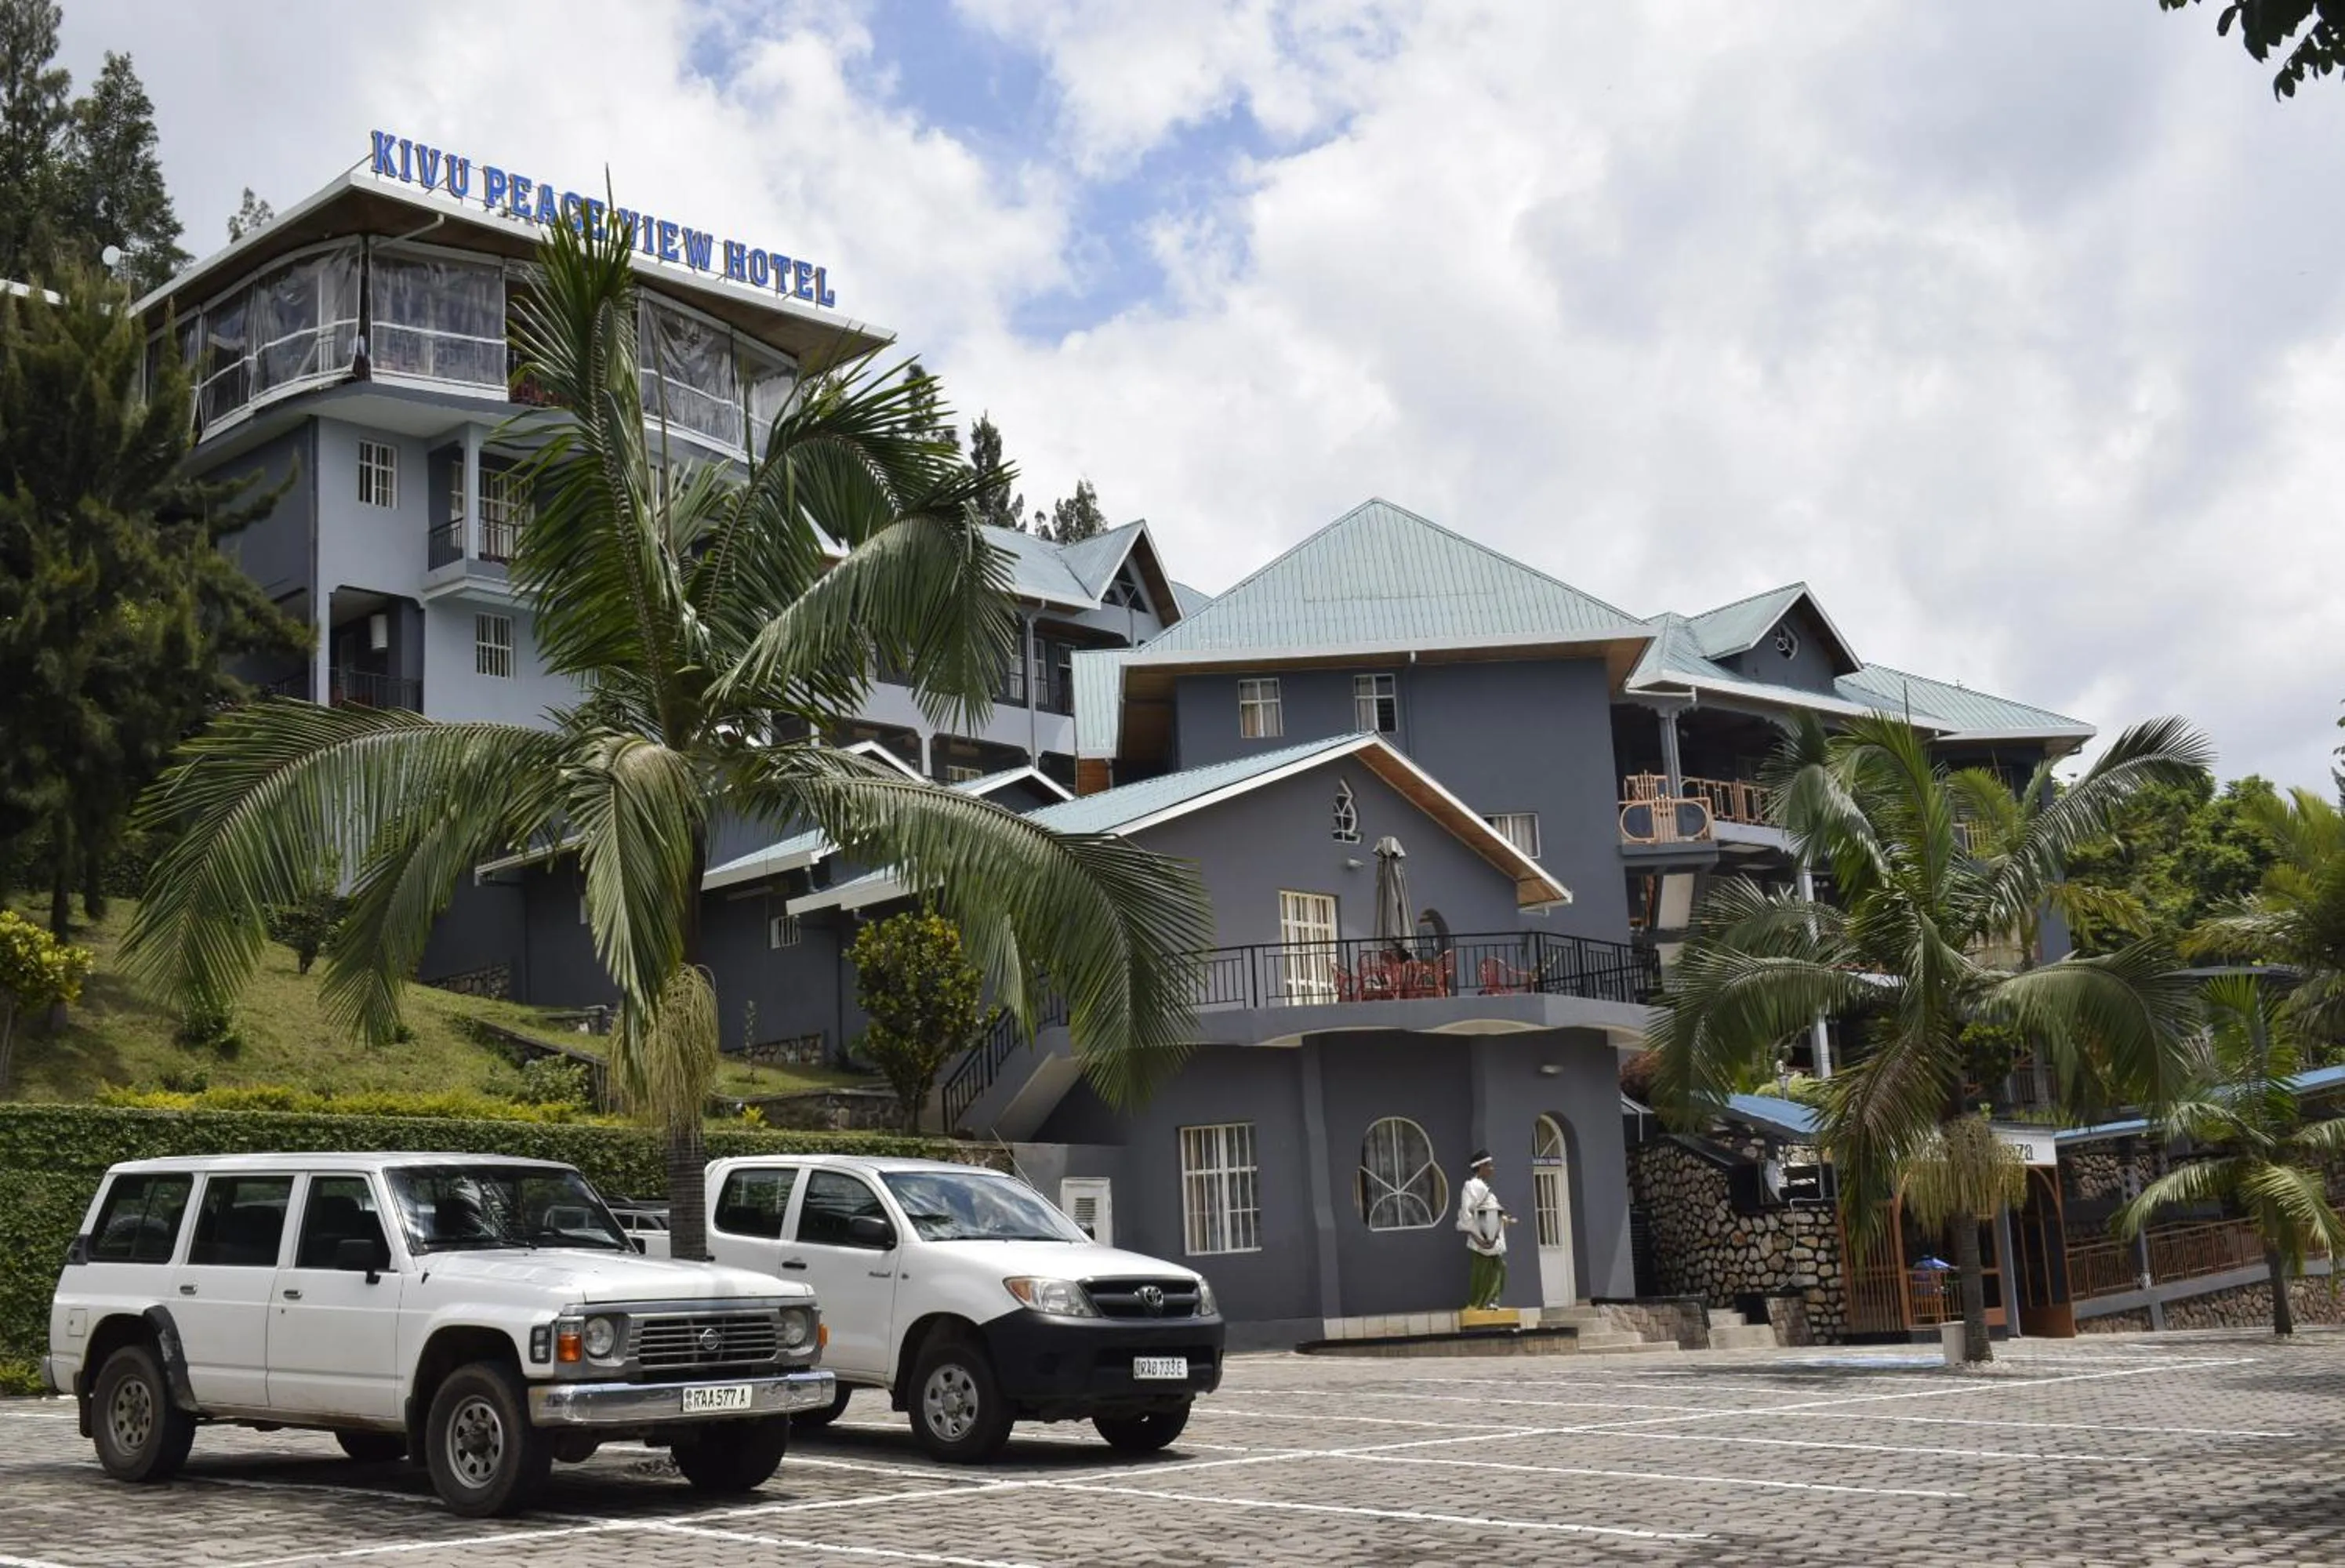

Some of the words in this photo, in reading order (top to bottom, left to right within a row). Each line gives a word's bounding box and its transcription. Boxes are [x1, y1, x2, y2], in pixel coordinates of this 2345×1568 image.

[370, 130, 470, 198] KIVU
[483, 165, 606, 241] PEACE
[617, 207, 713, 271] VIEW
[723, 239, 835, 308] HOTEL
